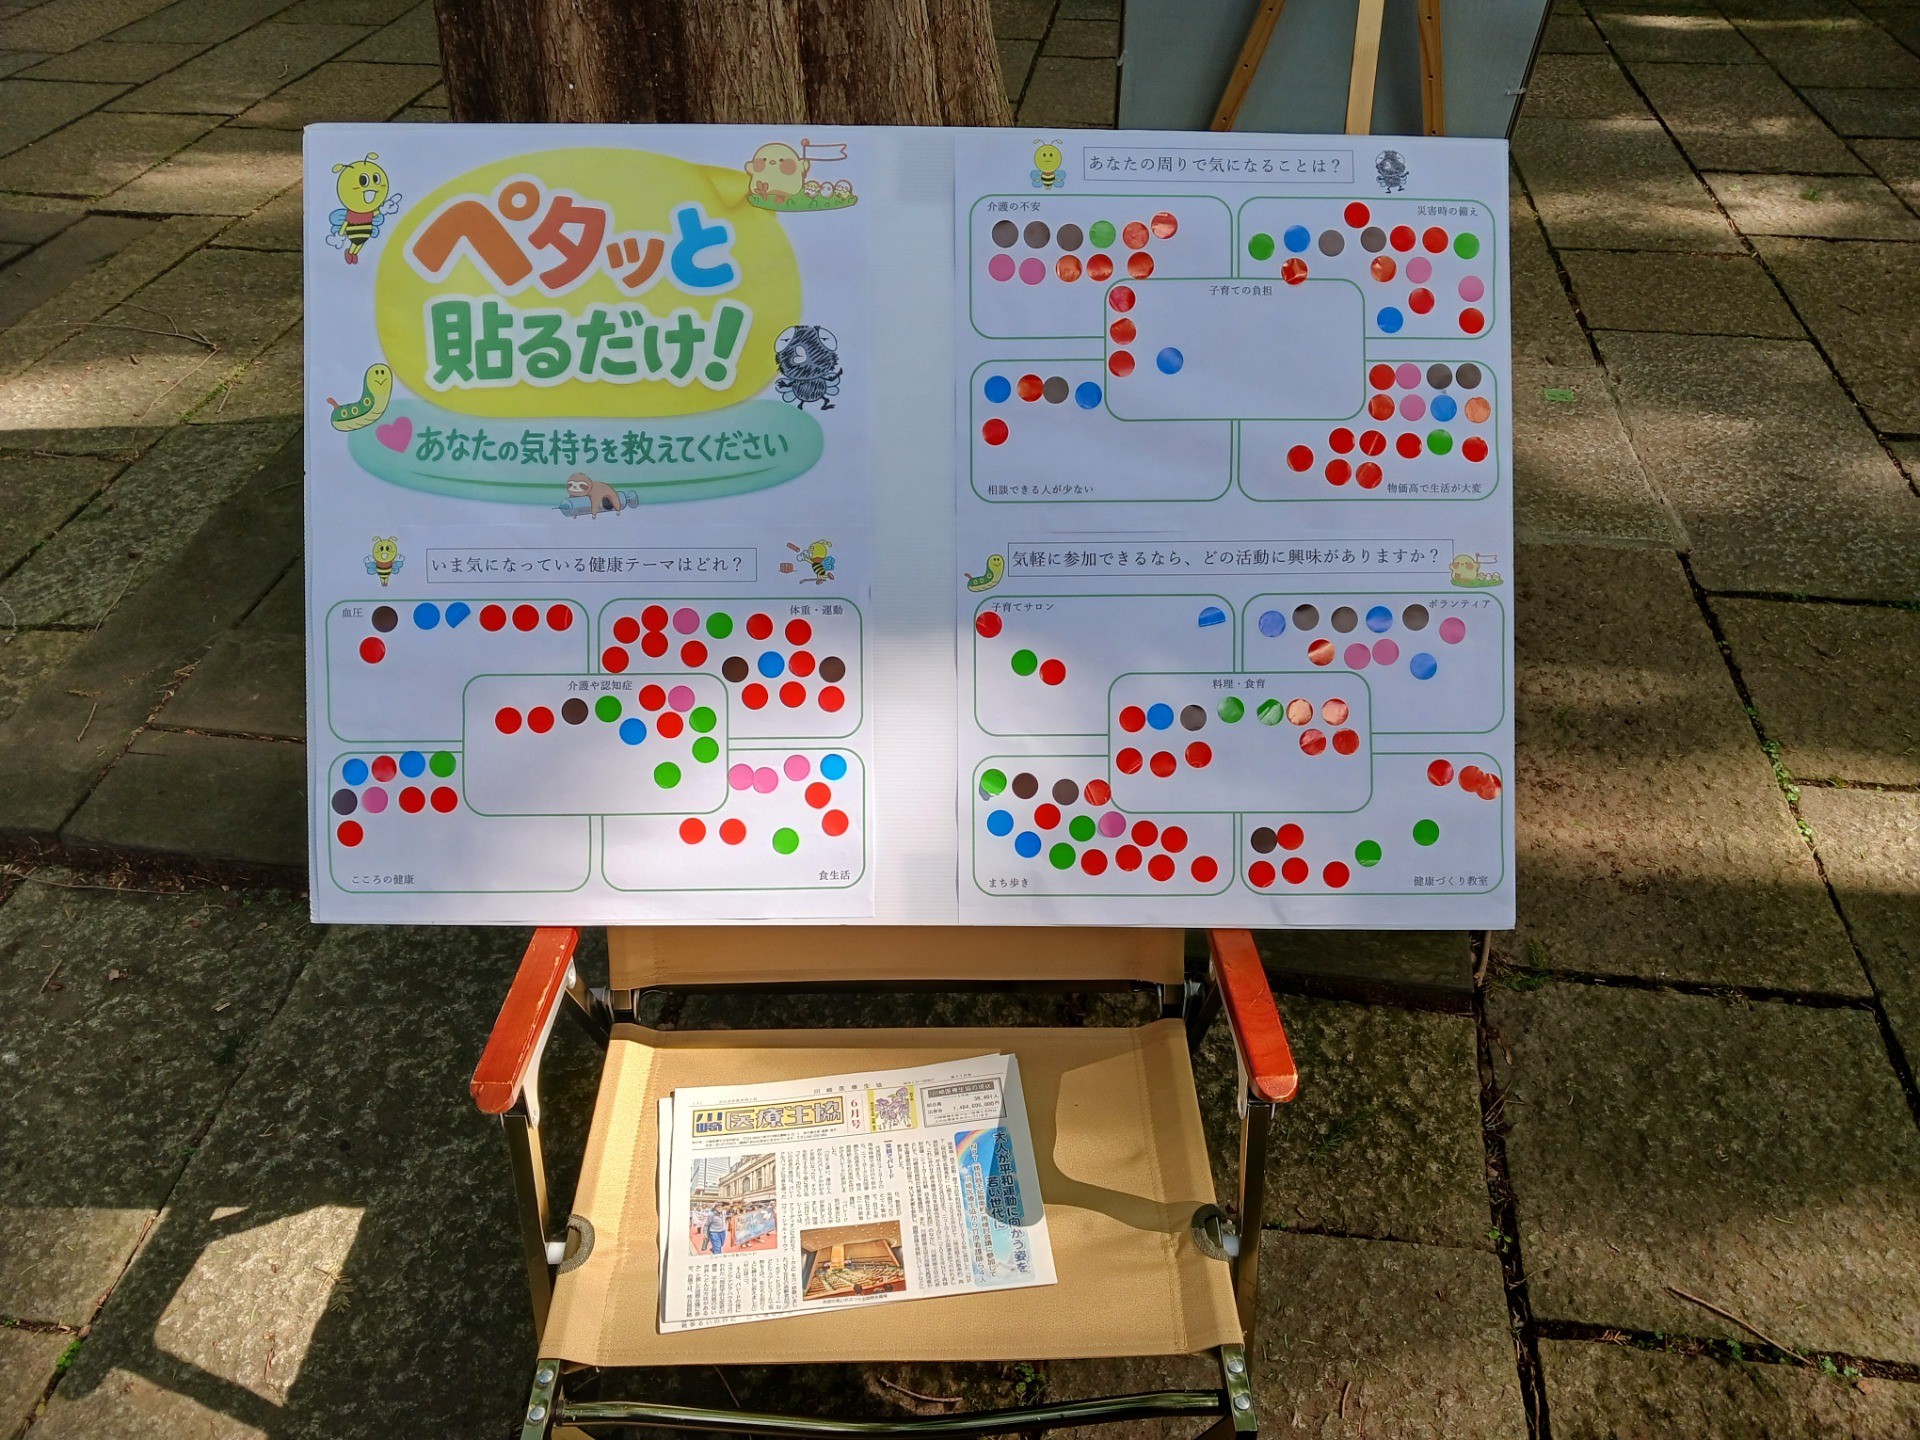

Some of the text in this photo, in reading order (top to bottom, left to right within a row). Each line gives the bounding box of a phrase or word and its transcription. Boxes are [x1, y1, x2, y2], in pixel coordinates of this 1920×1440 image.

[1088, 155, 1341, 173] あなたの周りで気になることは？
[986, 200, 1041, 213] 介護の不安
[1416, 205, 1479, 218] 災害時の備え
[411, 179, 735, 290] ペタッと
[1208, 284, 1273, 297] 子育ての負担
[431, 299, 746, 384] 貼るだけ！
[415, 428, 790, 467] あなたの気持ちを教えてください
[986, 482, 1095, 496] 相談できる人が少ない
[1386, 481, 1483, 495] 物価高で生活が大変
[431, 554, 743, 574] いま気になっている健康テーマはどれ？
[1011, 547, 1440, 569] 気軽に参加できるなら、どの活動に興味がありますか？
[788, 603, 844, 616] 体重・運動
[990, 601, 1055, 614] 子育てサロン
[1428, 598, 1491, 610] ボランティア
[341, 606, 364, 619] 血圧
[567, 679, 633, 692] 介護や認知症
[1211, 677, 1266, 690] 料理・食育
[351, 873, 415, 886] こころの健康
[817, 868, 852, 882] 食生活
[1412, 873, 1489, 888] 健康づくり教室
[988, 876, 1030, 889] まち歩き
[986, 1175, 1008, 1230] 若い世代に
[993, 1131, 1030, 1273] 大人が平和運動に向かう姿を
